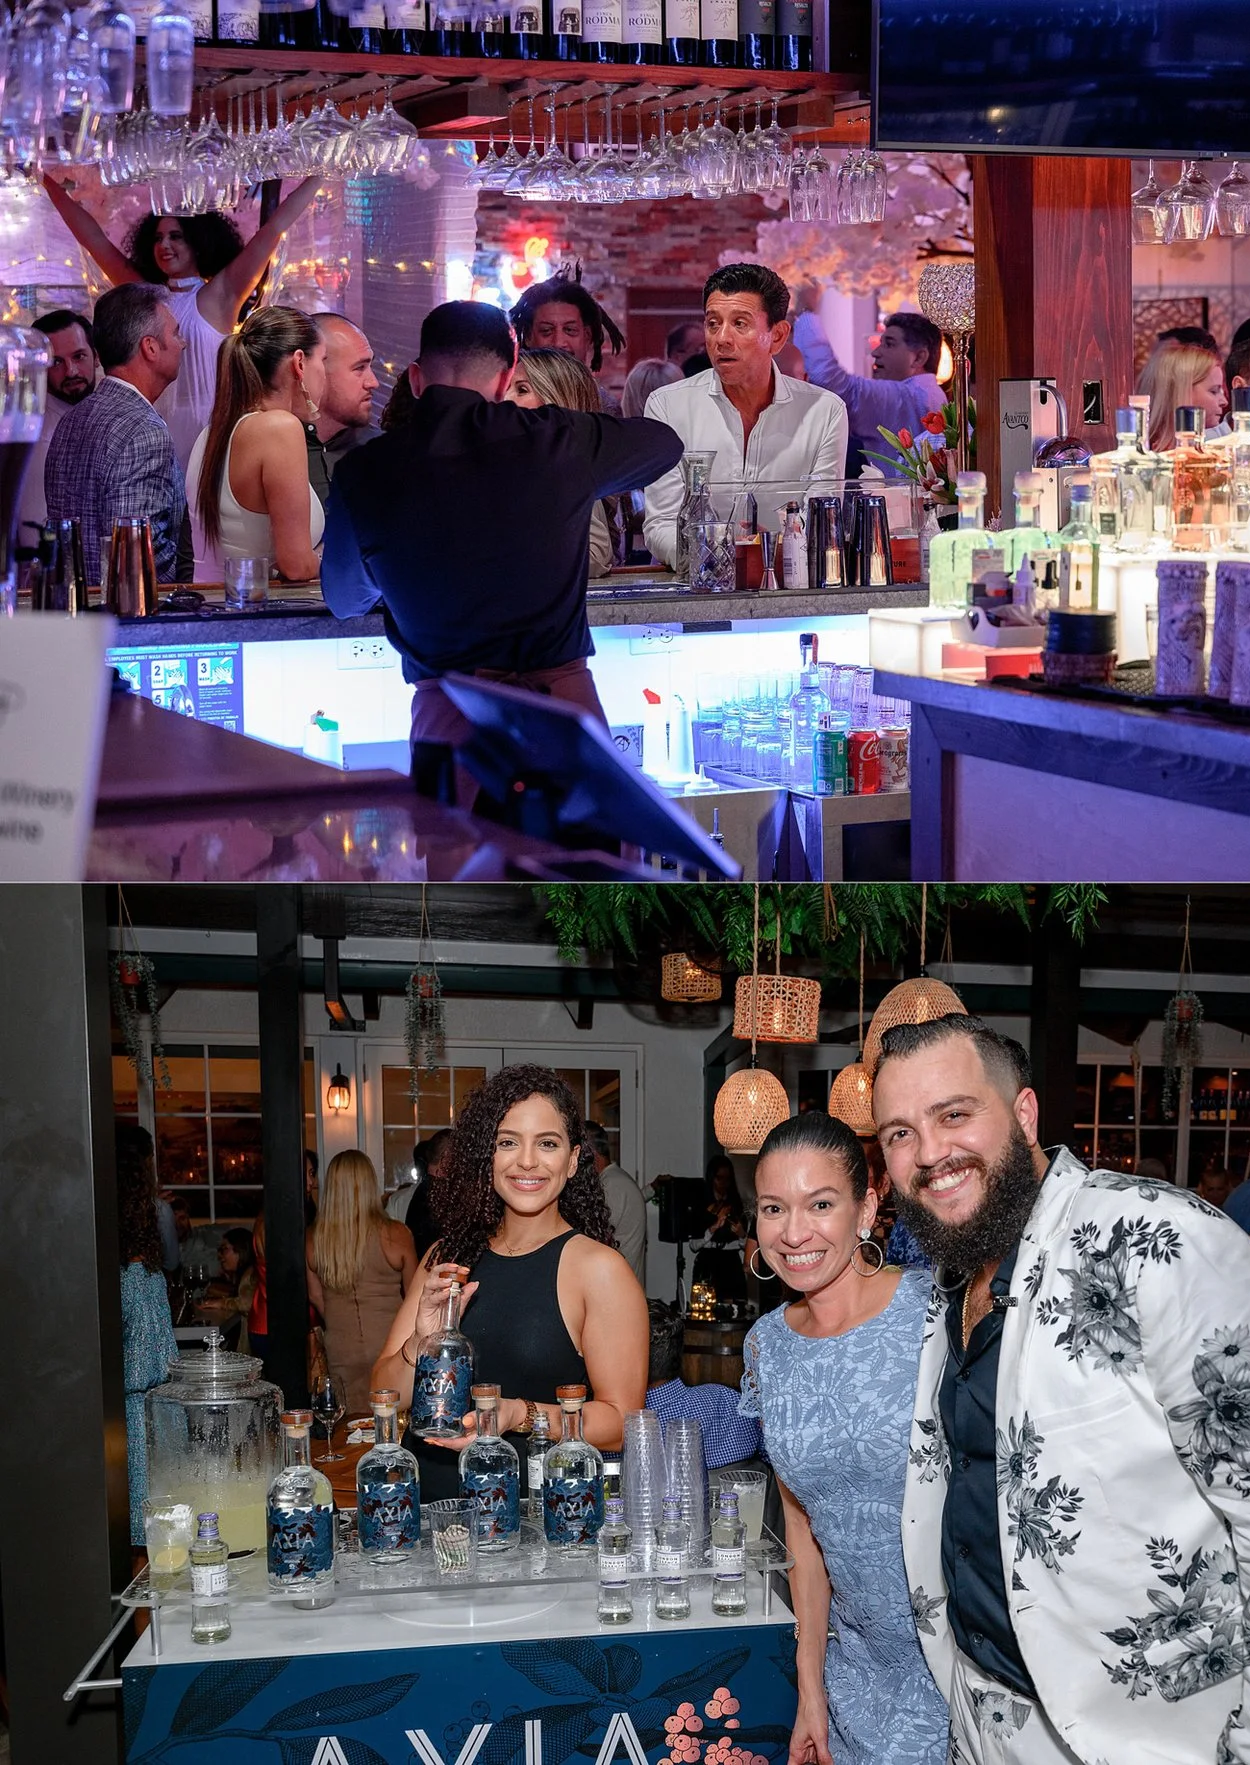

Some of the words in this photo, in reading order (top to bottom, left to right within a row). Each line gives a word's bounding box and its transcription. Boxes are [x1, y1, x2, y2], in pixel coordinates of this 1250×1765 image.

[154, 665, 161, 677] 2
[200, 662, 207, 674] 3
[154, 694, 162, 705] 5
[417, 1378, 456, 1395] AXIA
[372, 1504, 413, 1523] AXIA
[555, 1500, 596, 1518] AXIA
[271, 1531, 316, 1550] AXIA
